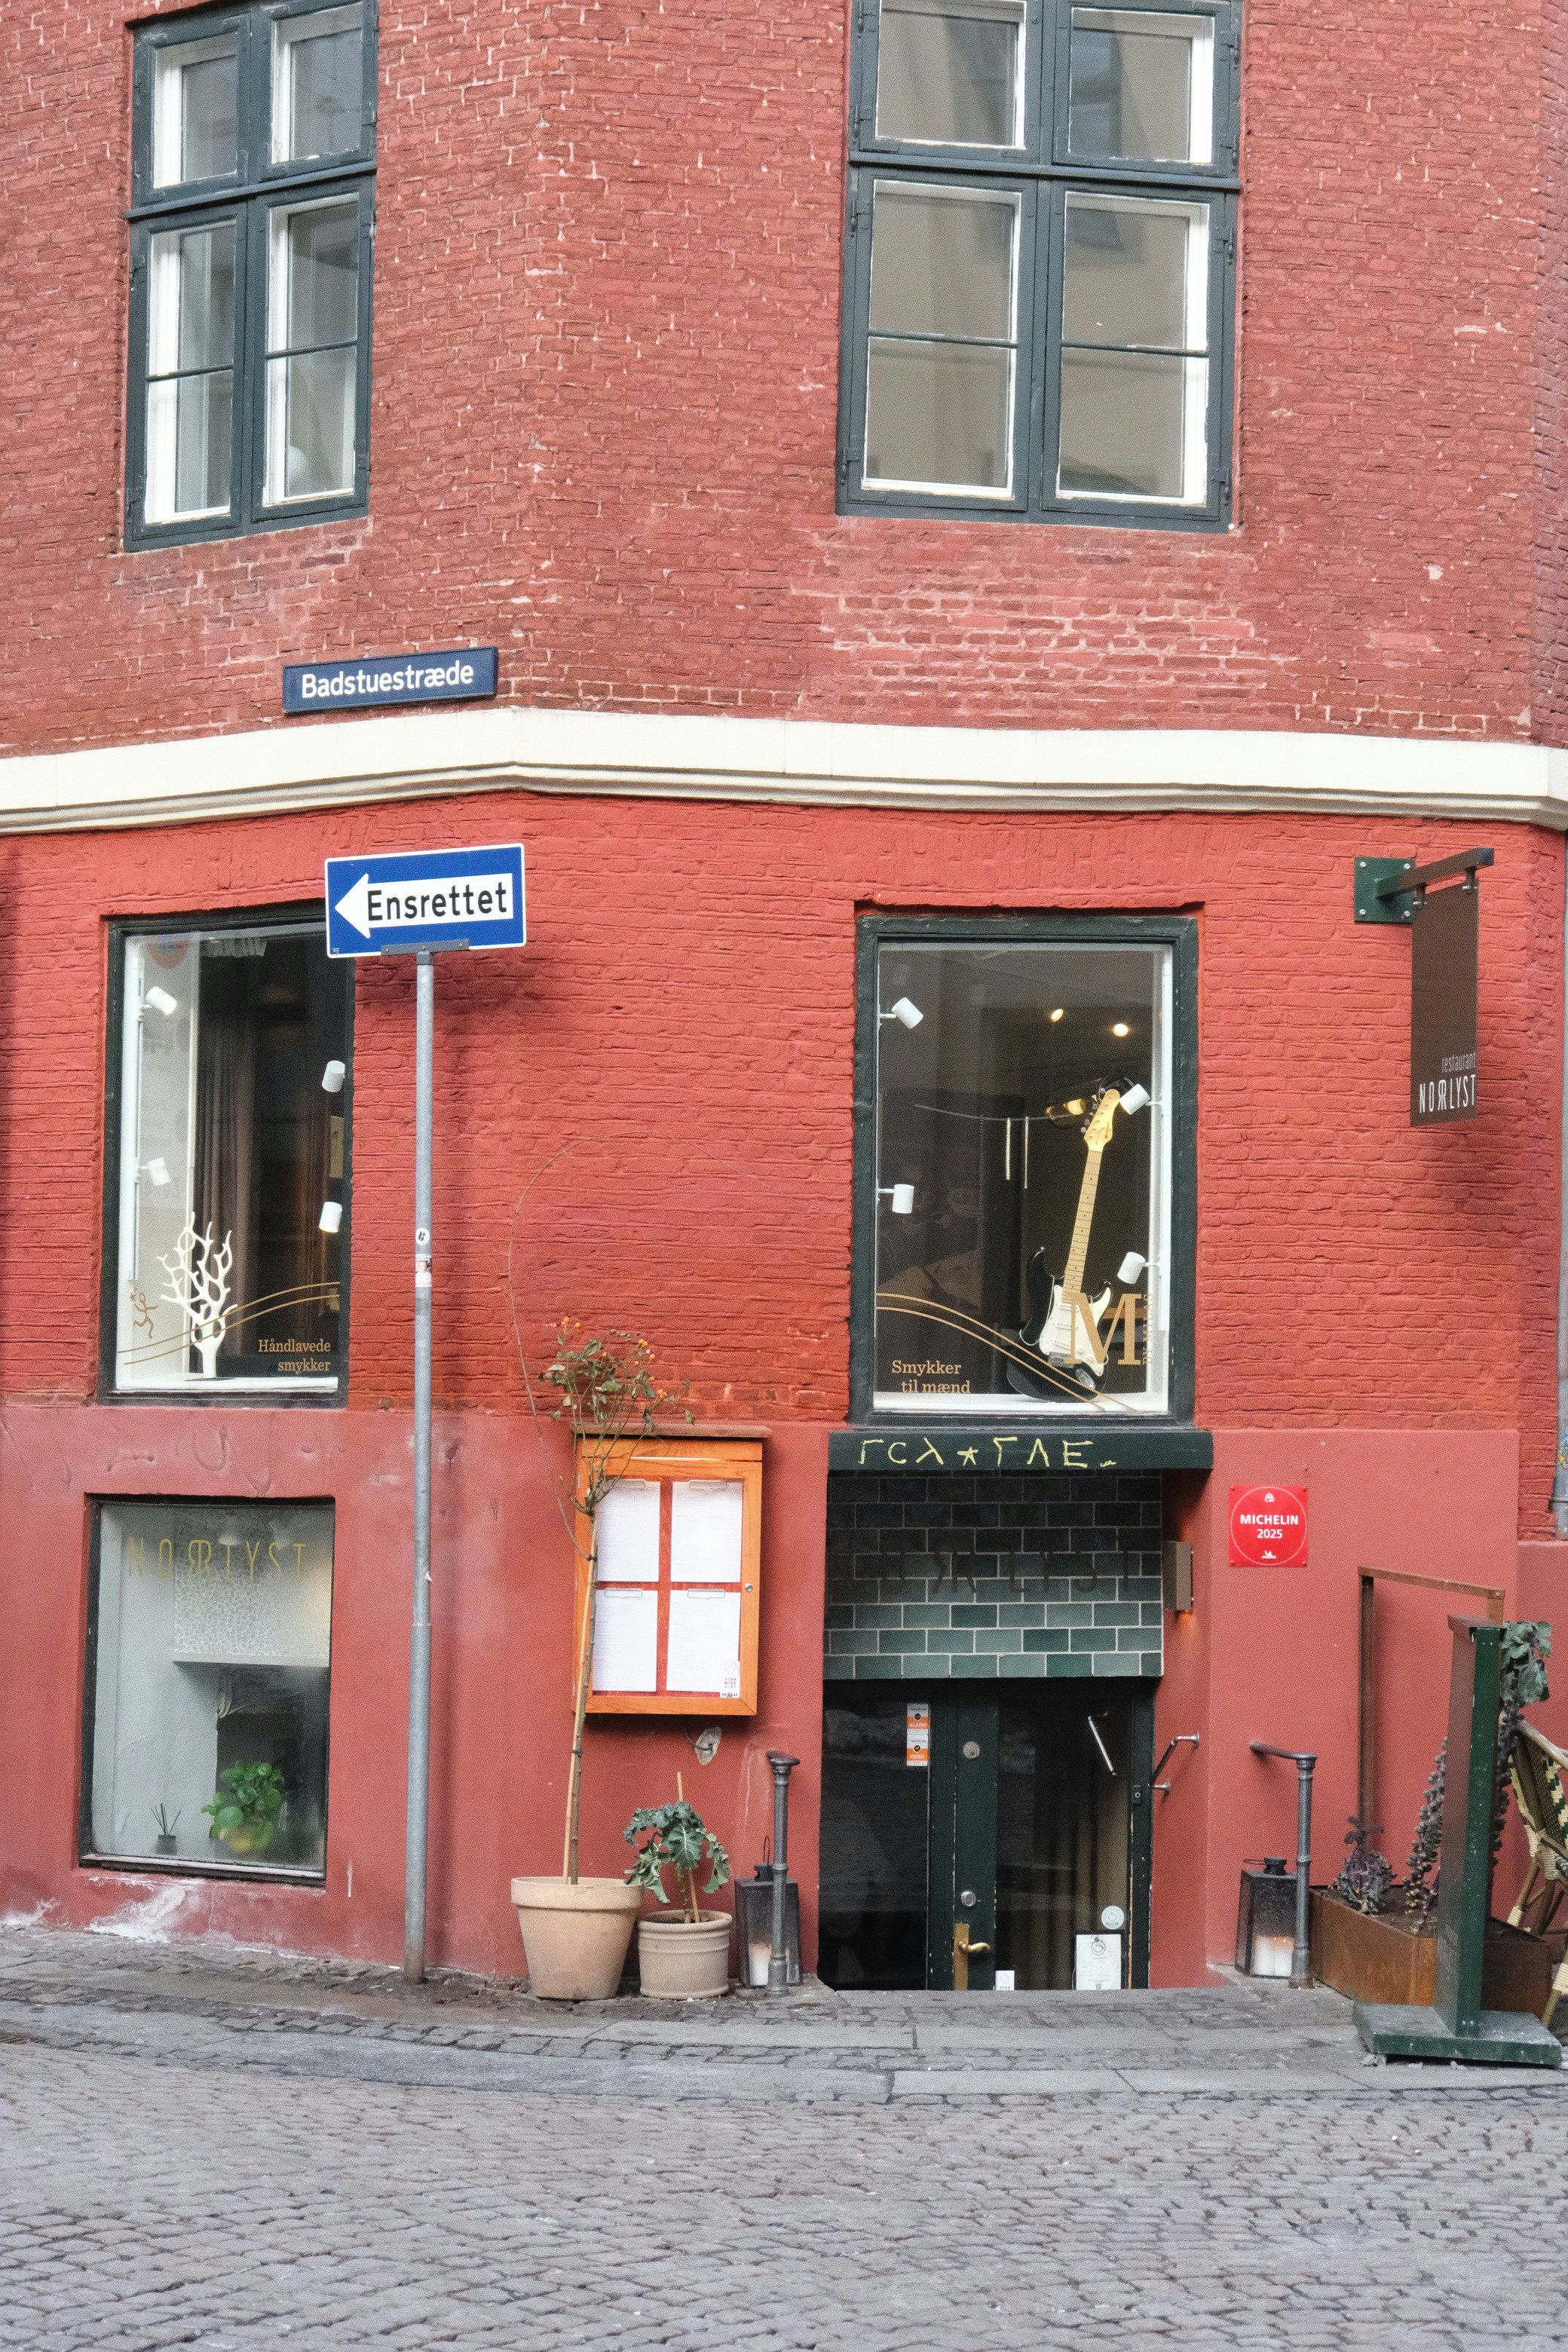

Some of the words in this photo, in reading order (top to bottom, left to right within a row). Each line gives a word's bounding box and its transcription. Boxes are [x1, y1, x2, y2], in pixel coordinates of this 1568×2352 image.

[302, 660, 474, 699] Badstuestræde
[368, 881, 507, 921] Ensrettet
[1441, 1051, 1476, 1073] restaurant
[258, 1338, 331, 1352] Håndlavede
[277, 1358, 331, 1375] smykker
[892, 1360, 961, 1377] Smykker
[902, 1380, 918, 1393] til
[922, 1380, 971, 1394] mænd
[1240, 1514, 1298, 1525] MICHELIN
[1257, 1529, 1283, 1539] 2025
